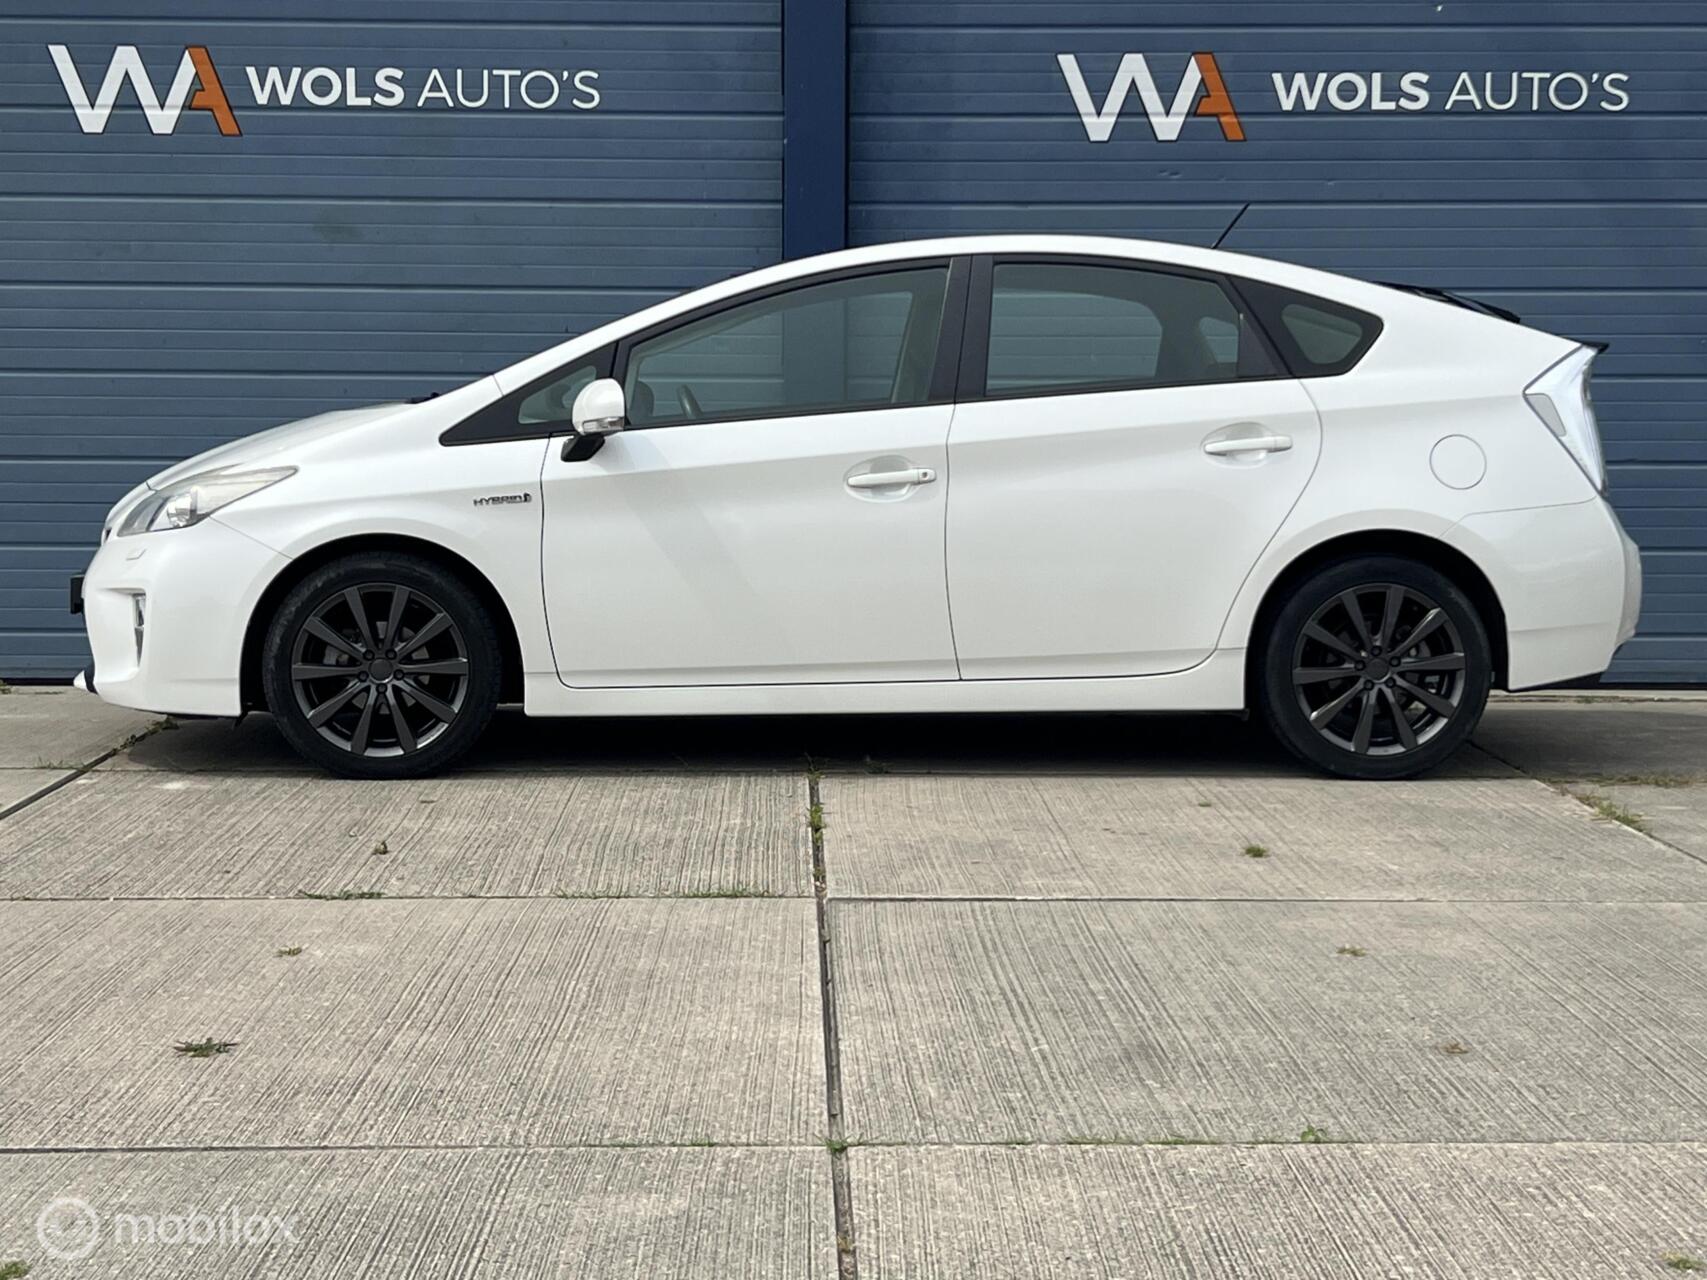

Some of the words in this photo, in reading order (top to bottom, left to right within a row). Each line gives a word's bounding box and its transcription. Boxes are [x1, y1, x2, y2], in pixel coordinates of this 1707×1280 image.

[47, 44, 242, 137] WA
[245, 66, 405, 107] WOLS
[415, 68, 602, 110] AUTO'S
[1056, 52, 1246, 142] WA
[1271, 72, 1430, 111] WOLS
[1444, 72, 1630, 112] AUTO'S
[473, 495, 523, 506] HYBRID
